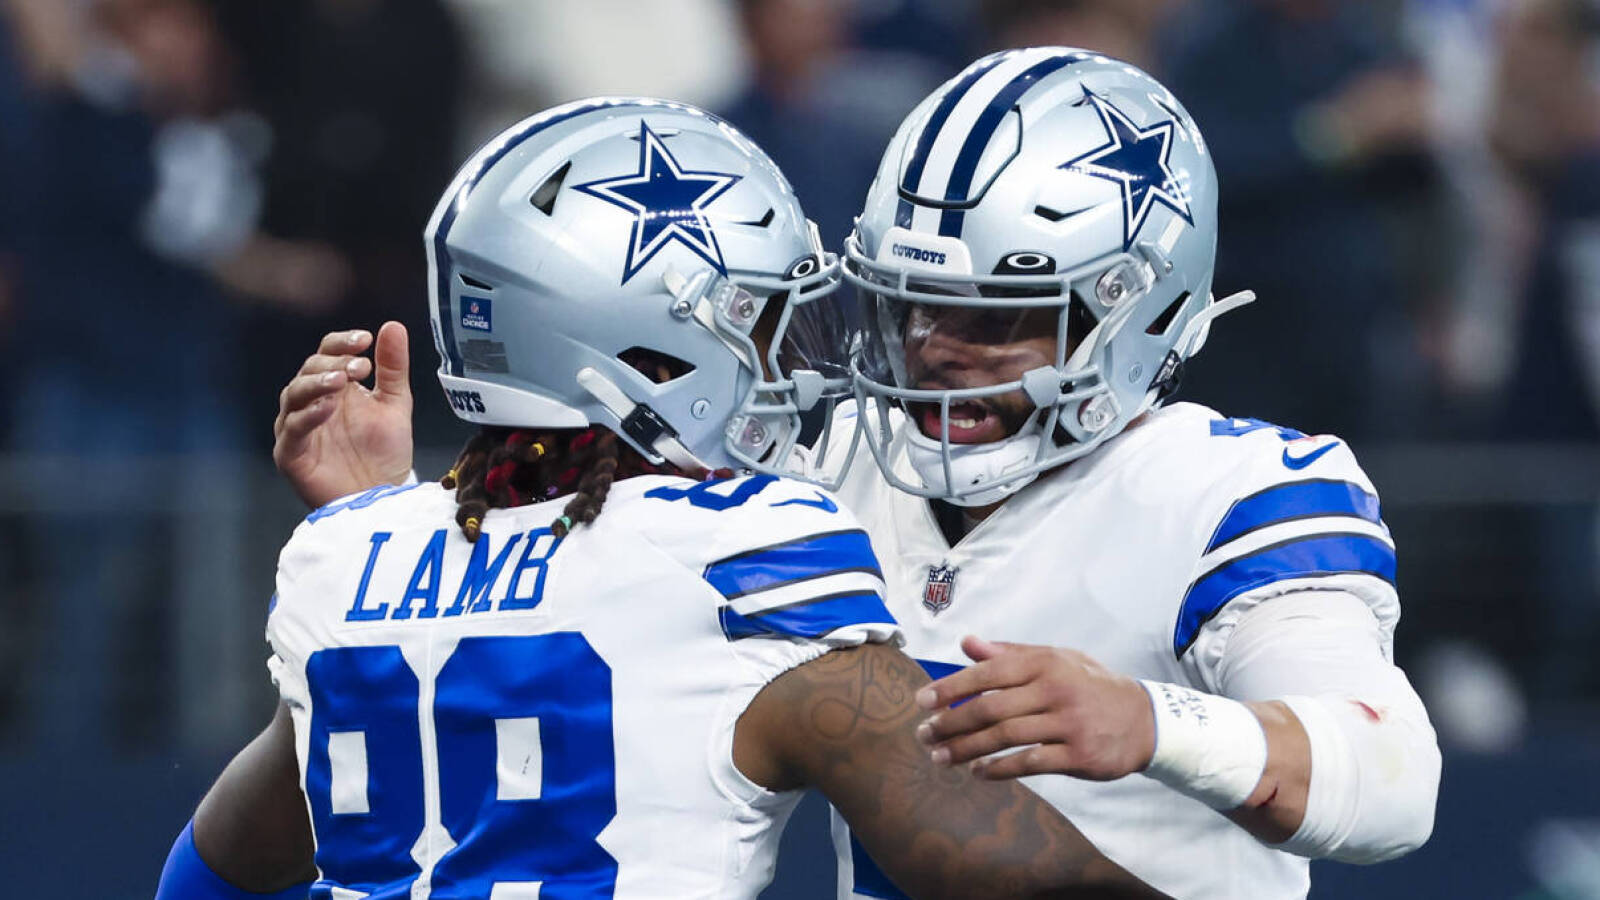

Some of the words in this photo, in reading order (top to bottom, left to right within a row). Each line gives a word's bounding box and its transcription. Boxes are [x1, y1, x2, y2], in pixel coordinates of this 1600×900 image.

[892, 243, 947, 266] COWBOYS
[344, 526, 566, 623] LAMB
[305, 631, 619, 900] 88
